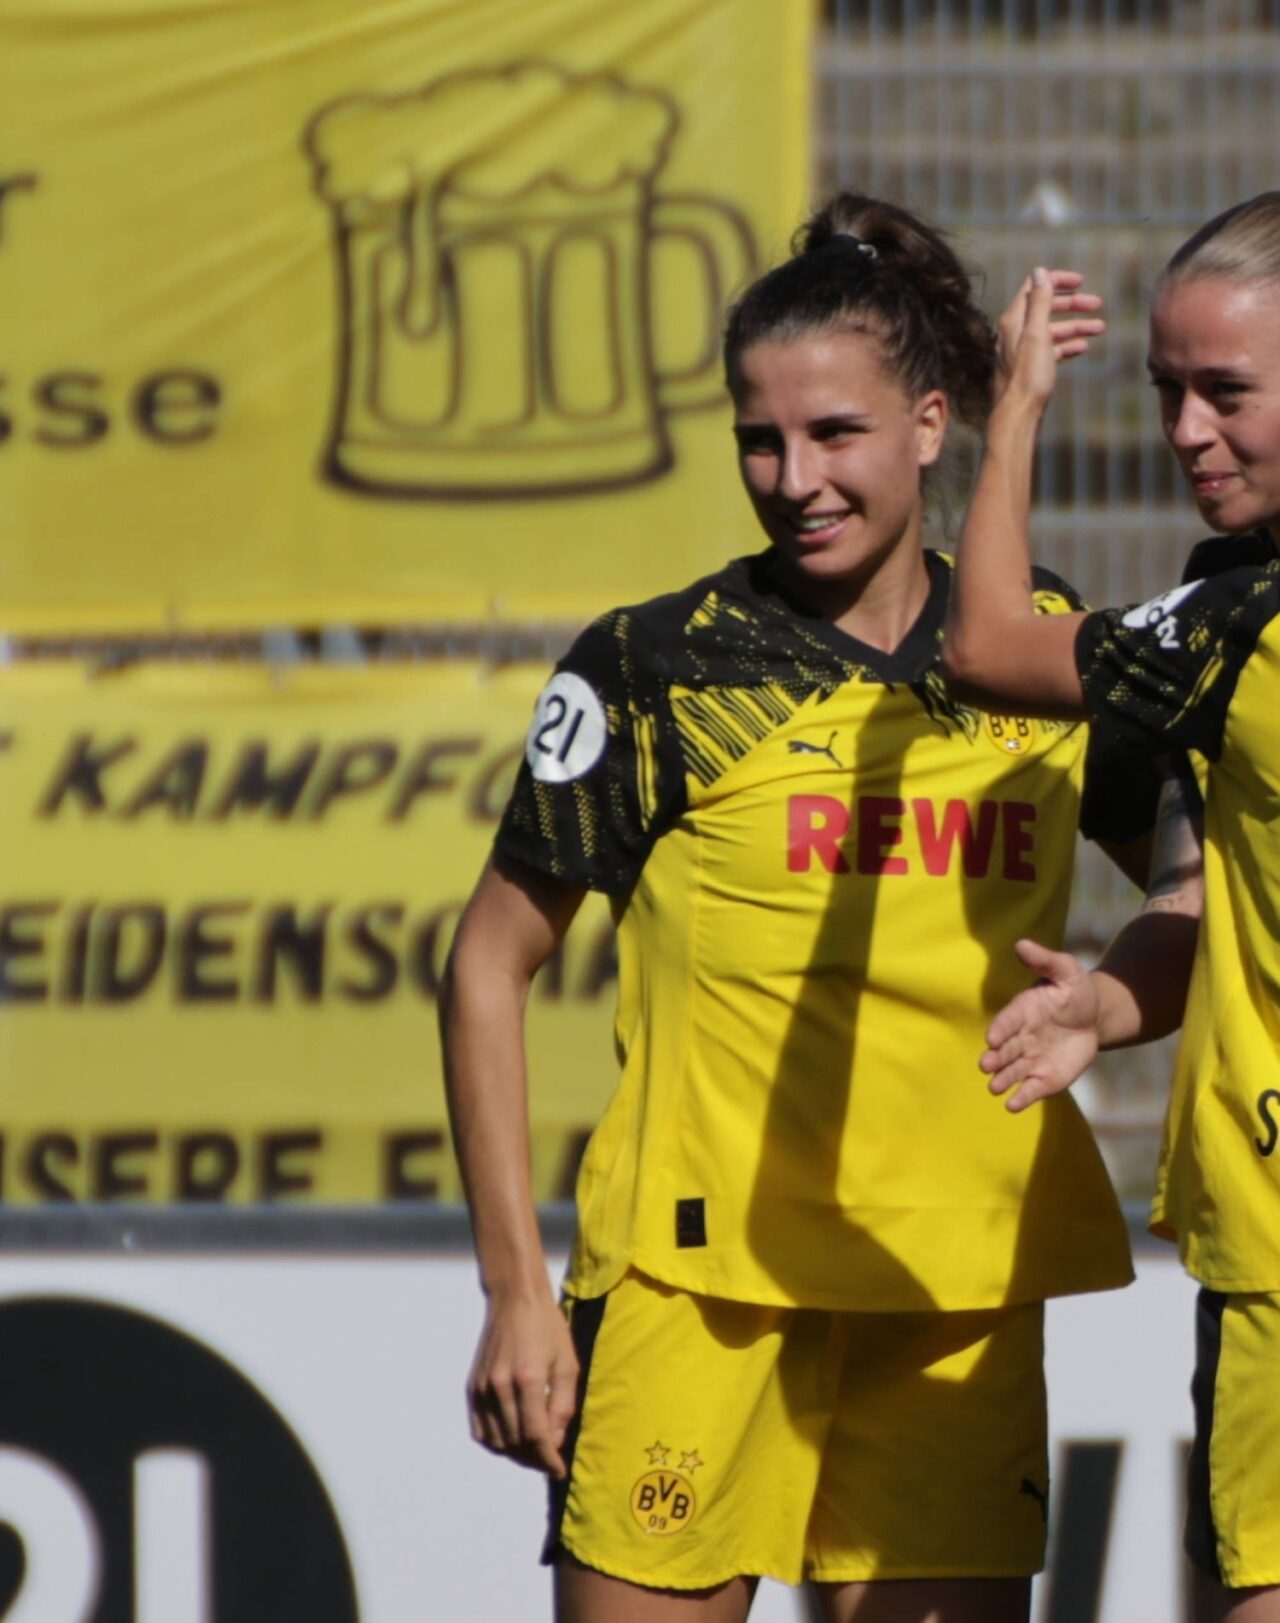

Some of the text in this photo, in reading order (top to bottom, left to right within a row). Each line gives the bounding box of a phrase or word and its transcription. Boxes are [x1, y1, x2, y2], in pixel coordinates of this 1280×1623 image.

[0, 369, 221, 448] se
[534, 693, 585, 764] 21
[786, 794, 1036, 883] REWE
[637, 1475, 691, 1520] BVB
